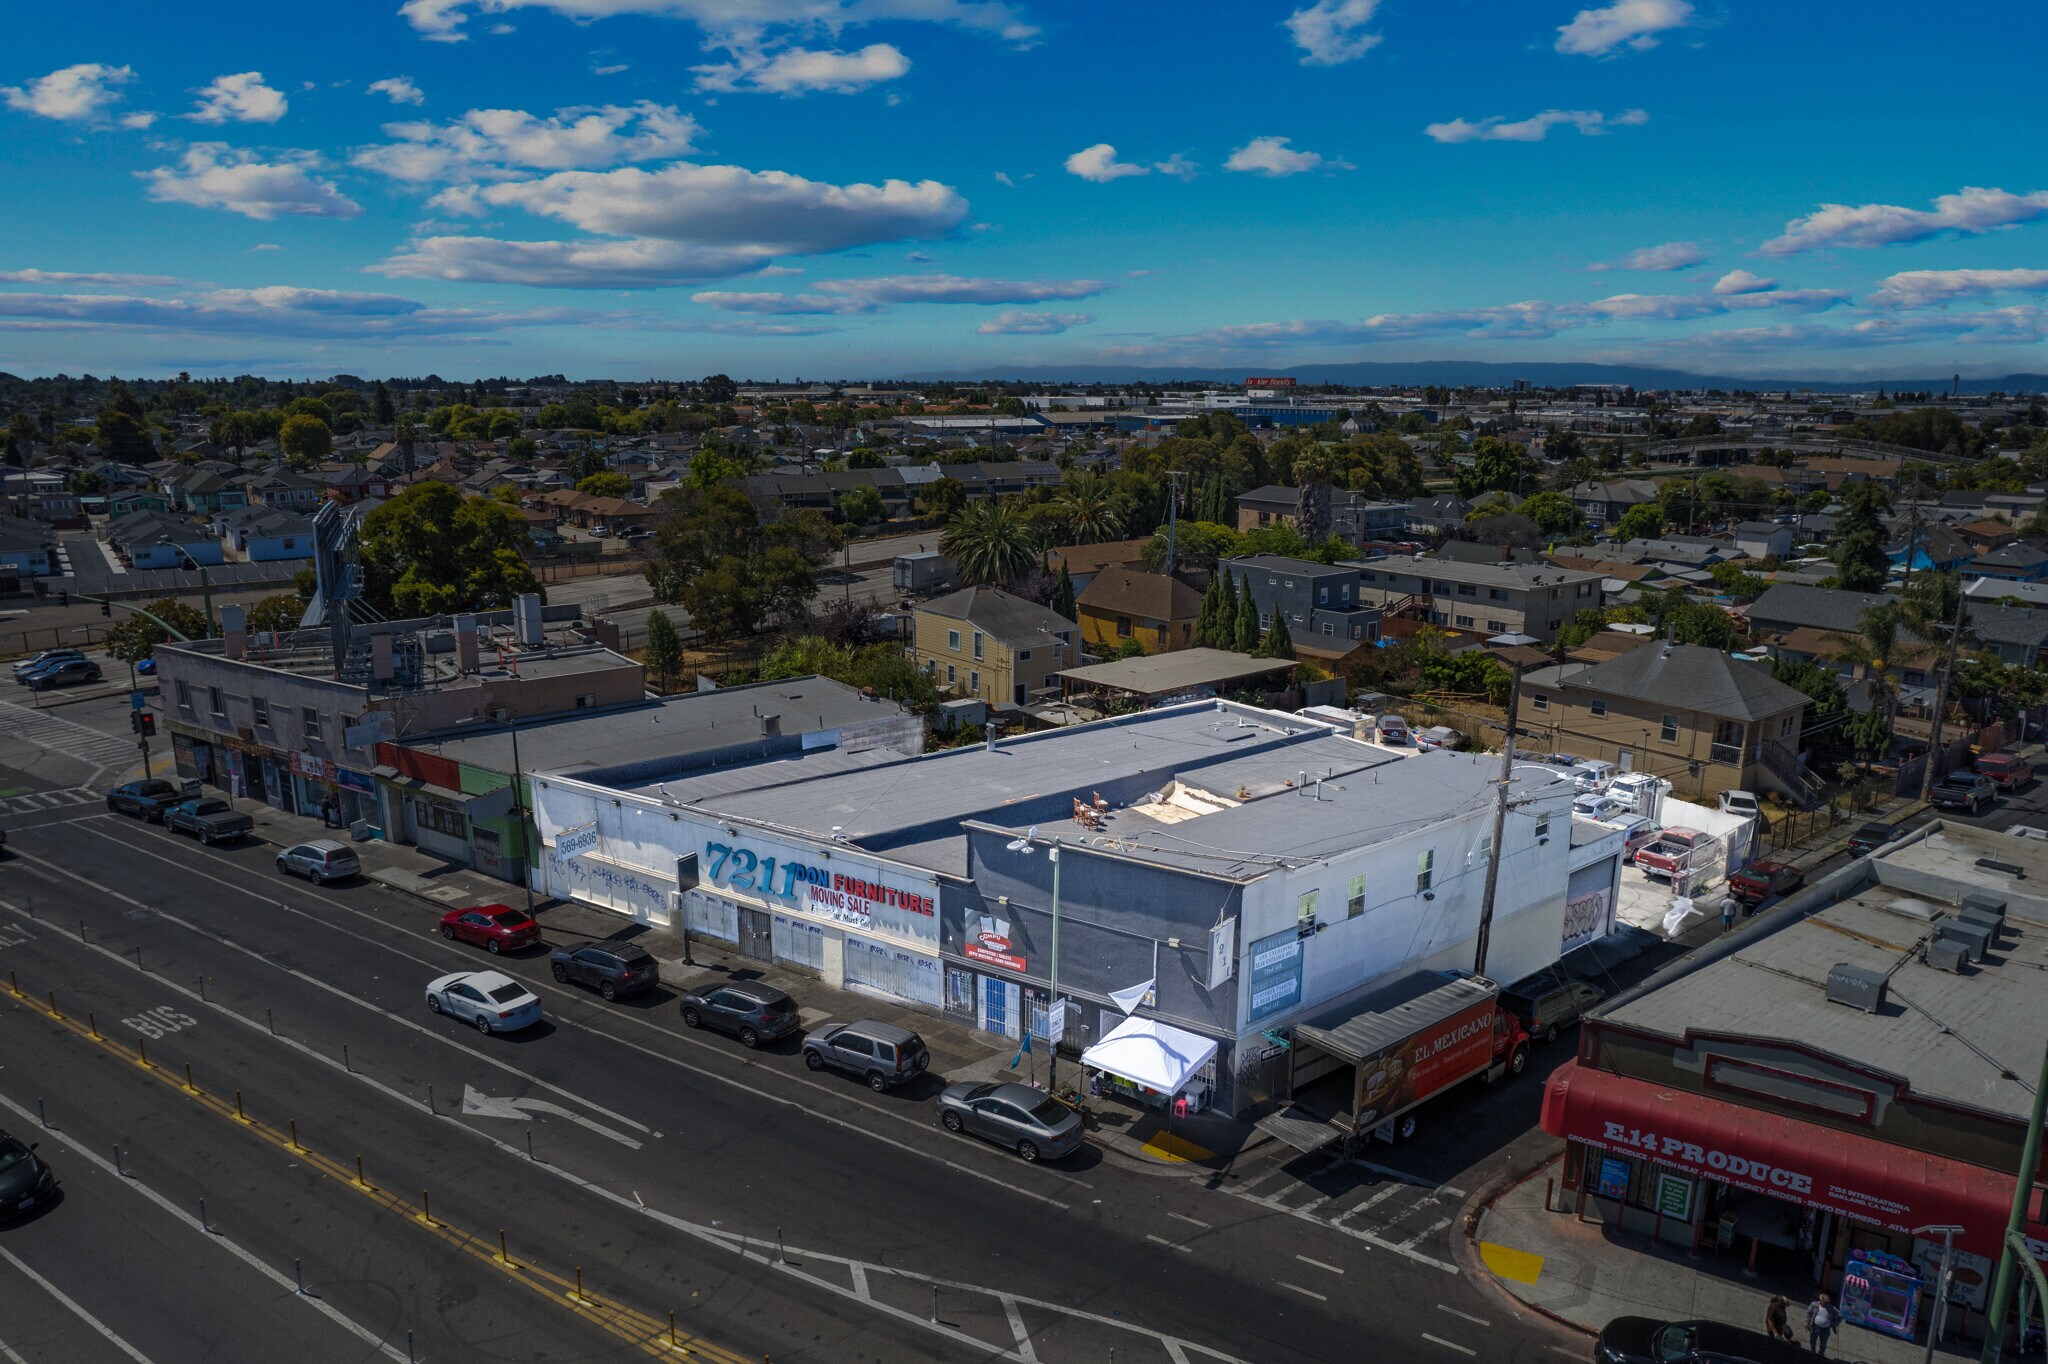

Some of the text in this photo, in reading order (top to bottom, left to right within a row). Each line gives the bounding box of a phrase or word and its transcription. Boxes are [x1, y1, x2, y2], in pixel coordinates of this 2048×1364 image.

[561, 831, 597, 854] 569-6936
[706, 841, 799, 901] 7211
[796, 863, 829, 888] DON
[833, 874, 934, 917] FURNITURE
[811, 885, 844, 909] MOVING
[847, 896, 870, 917] SALE
[121, 1005, 198, 1040] BUS
[1415, 1045, 1430, 1063] EL
[1432, 1012, 1492, 1054] MEXICANO
[1603, 1121, 1657, 1152] E.14
[1661, 1136, 1812, 1194] PRODUCE
[1568, 1133, 1909, 1234] GROCERIES PRODUCE FRESH MEAT FRUITS MONEY ORDERS ENVIO DE DINERO ATM
[1867, 1201, 1879, 1209] CA
